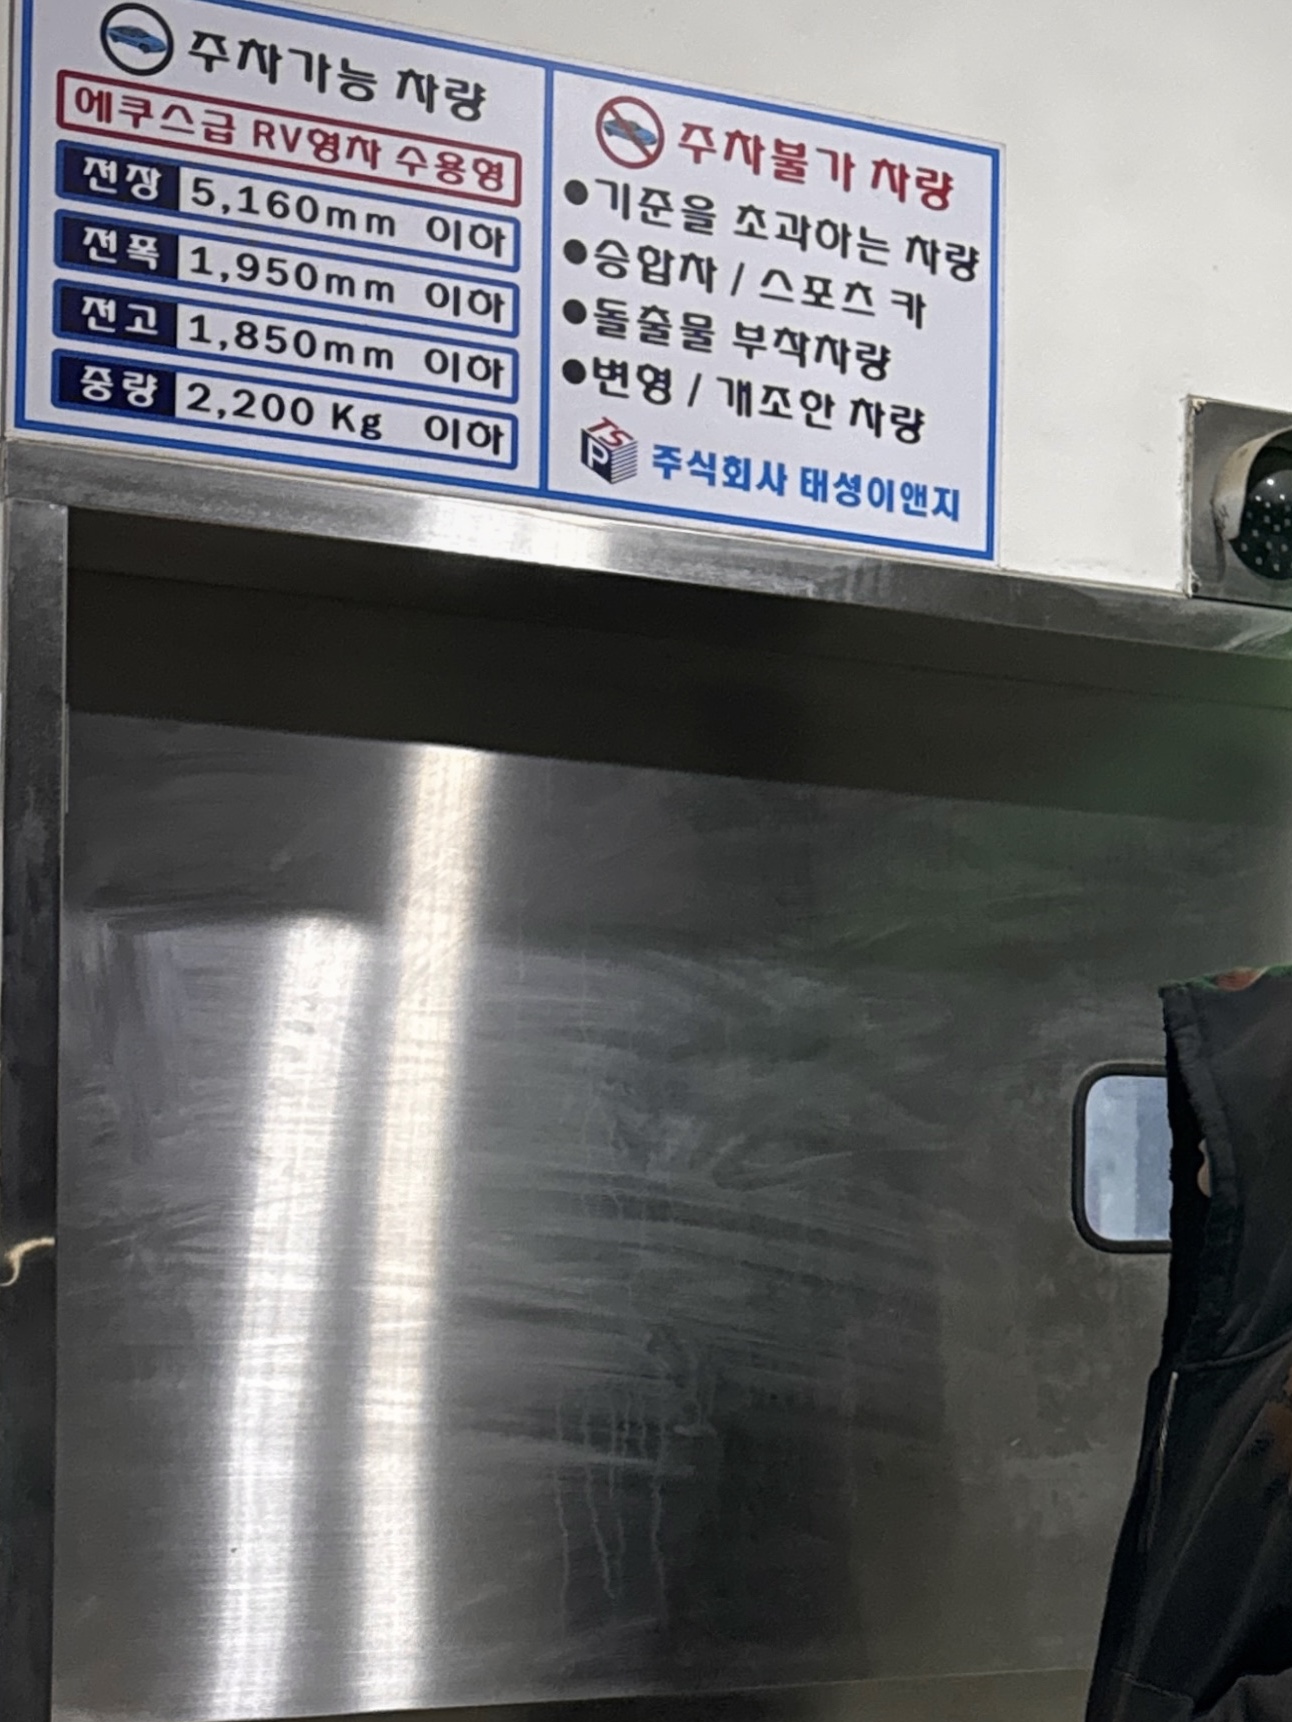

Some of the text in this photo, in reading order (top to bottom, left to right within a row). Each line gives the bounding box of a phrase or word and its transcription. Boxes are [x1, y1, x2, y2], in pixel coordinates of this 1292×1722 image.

[74, 86, 236, 145] 에쿠스급
[188, 30, 487, 121] 주차가능 차량
[82, 156, 506, 258] 전장 5,160mm 이하
[678, 122, 954, 211] 주차불가 차량
[82, 225, 506, 324] 전폭 1,950mm 이하
[594, 238, 718, 294] 승합차
[595, 179, 980, 282] 기준을 초과하는 차량
[81, 295, 505, 389] 전고 1,850mm 이하
[594, 297, 892, 382] 돌출물 부착차량
[80, 365, 505, 456] 중량 2,200 Kg 이하
[587, 416, 634, 449] TS
[716, 377, 835, 430] 개조한
[849, 397, 925, 444] 차량
[653, 444, 788, 496] 주식회사
